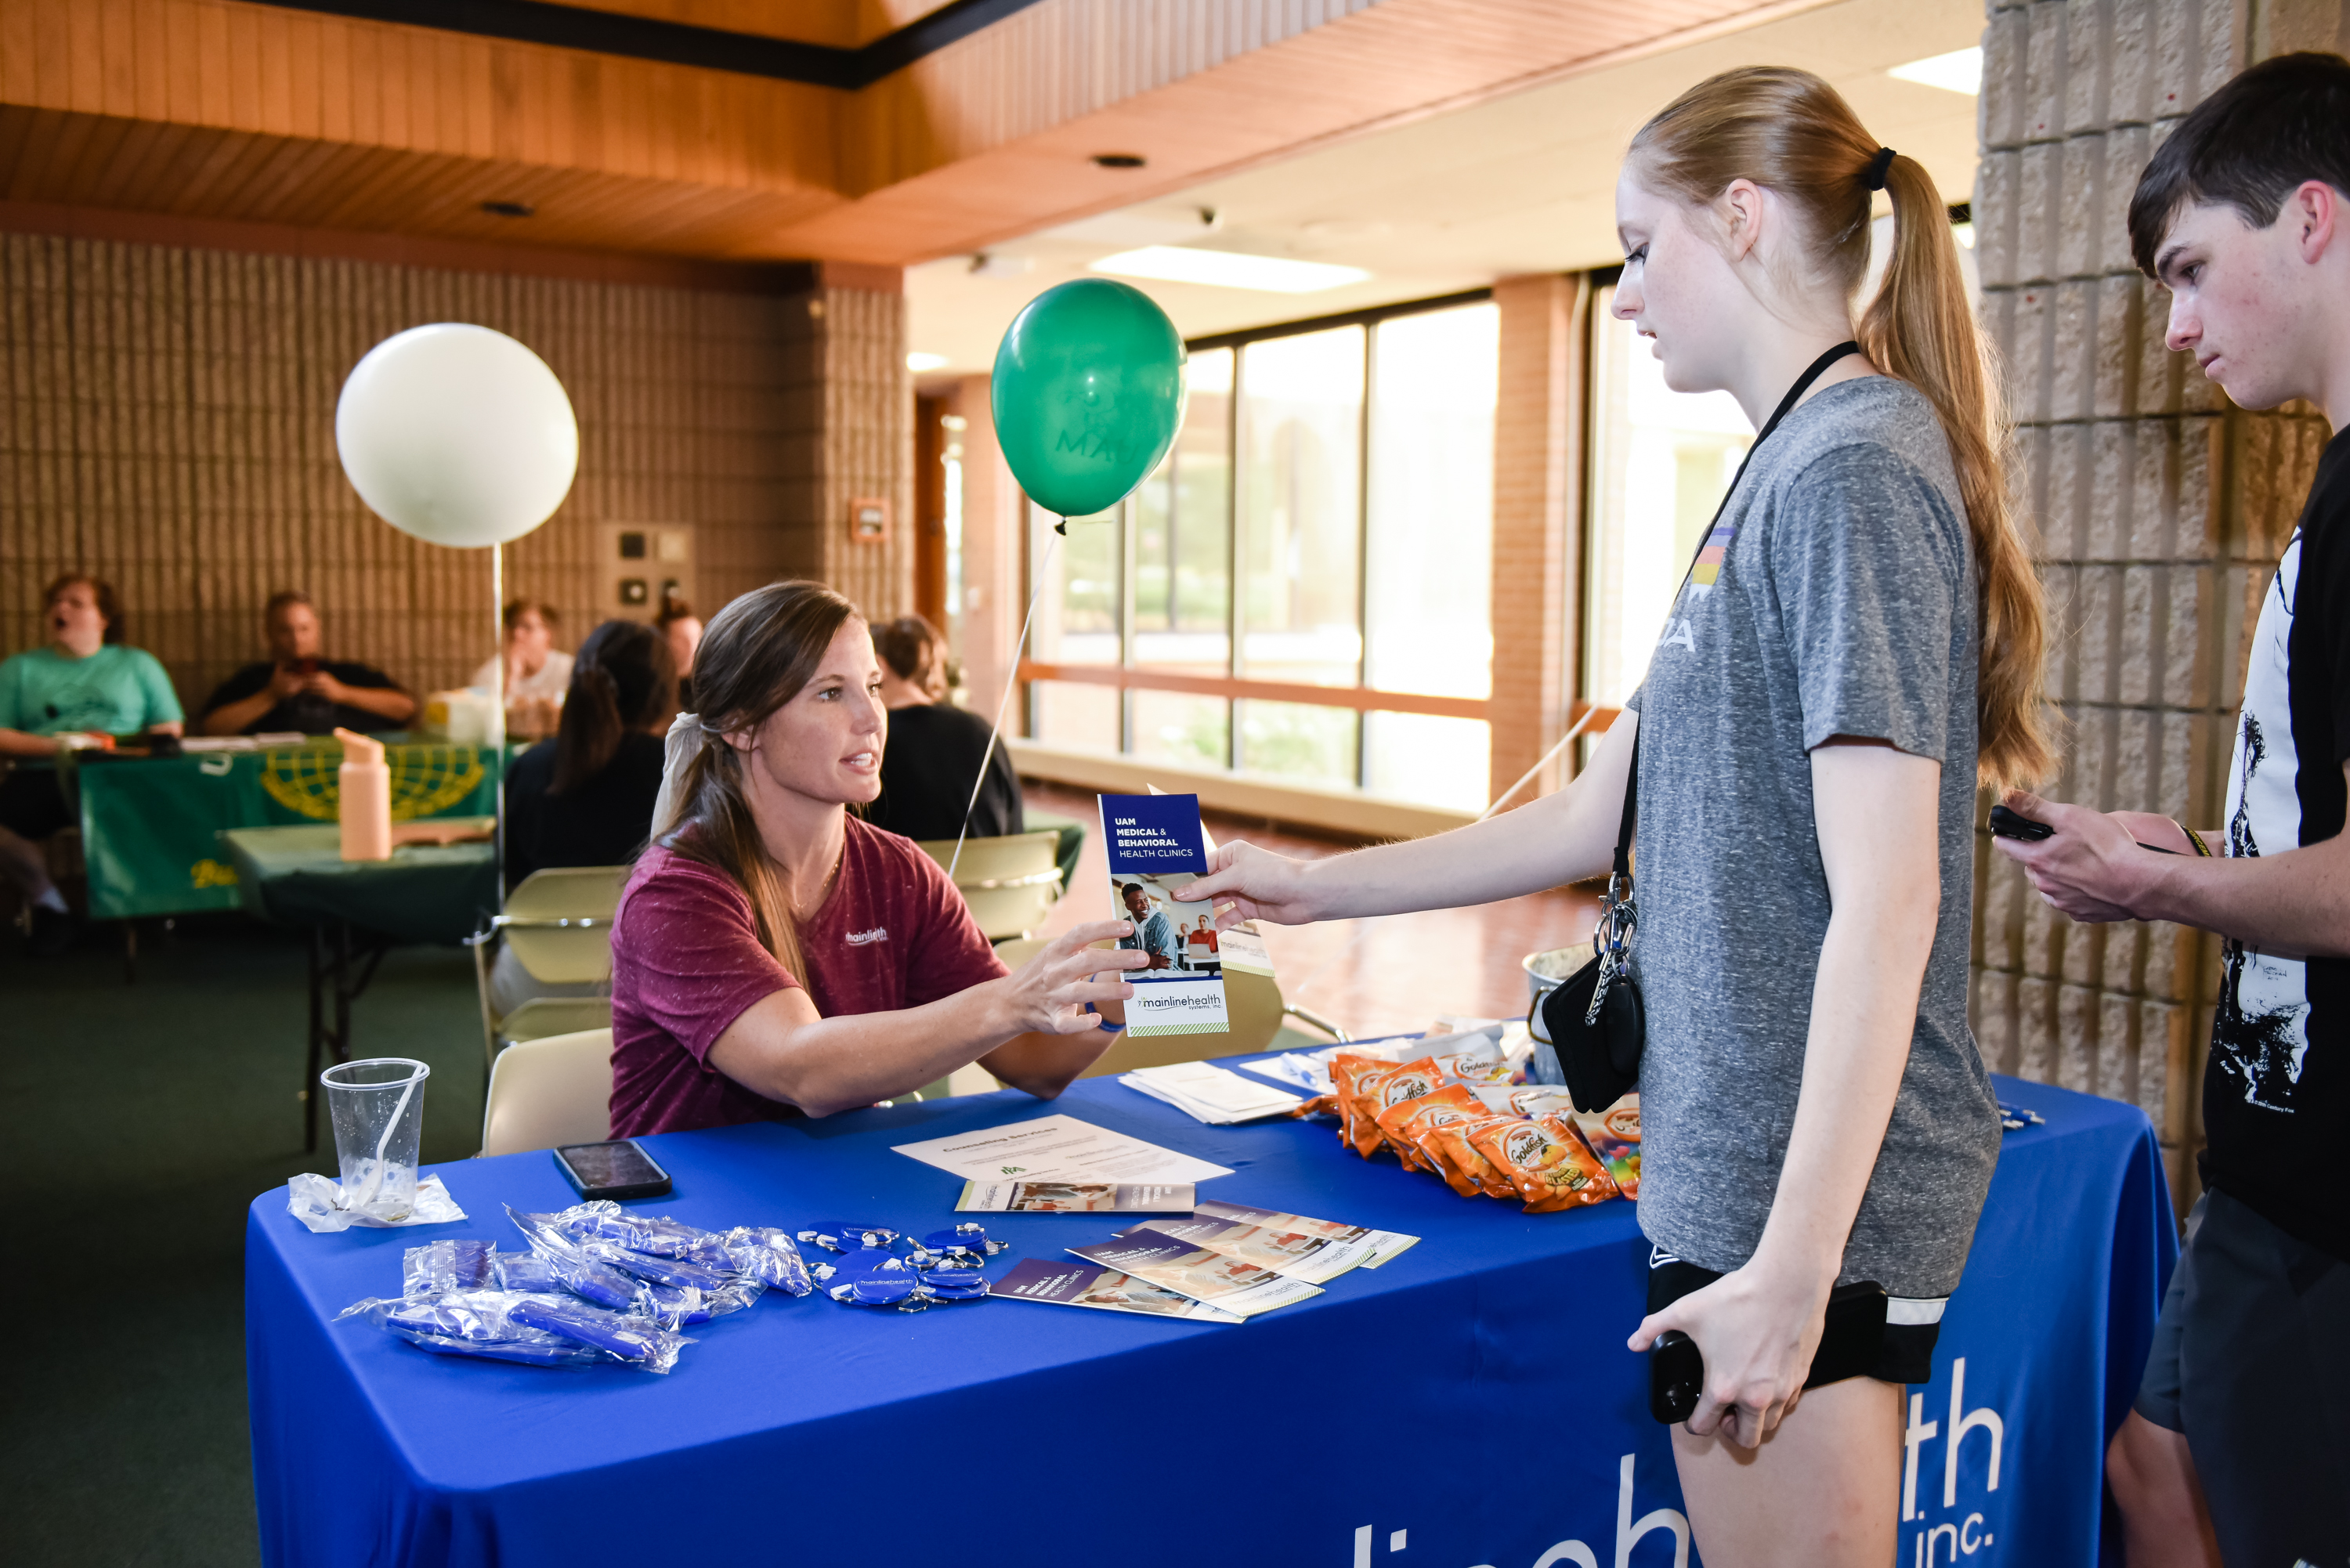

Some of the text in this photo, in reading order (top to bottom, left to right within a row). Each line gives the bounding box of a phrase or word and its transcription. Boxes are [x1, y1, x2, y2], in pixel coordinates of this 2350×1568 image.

[1143, 993, 1220, 1008] mainlinehealth
[1511, 1133, 1548, 1165] Goldfish
[1101, 1250, 1140, 1259] MEDICAL
[1109, 1247, 1162, 1263] BEHAVIORAL
[1149, 1245, 1180, 1258] CLINICS
[1036, 1274, 1068, 1296] BEHAVIORAL
[1064, 1270, 1084, 1285] CLINICS
[1915, 1510, 1994, 1568] inc.
